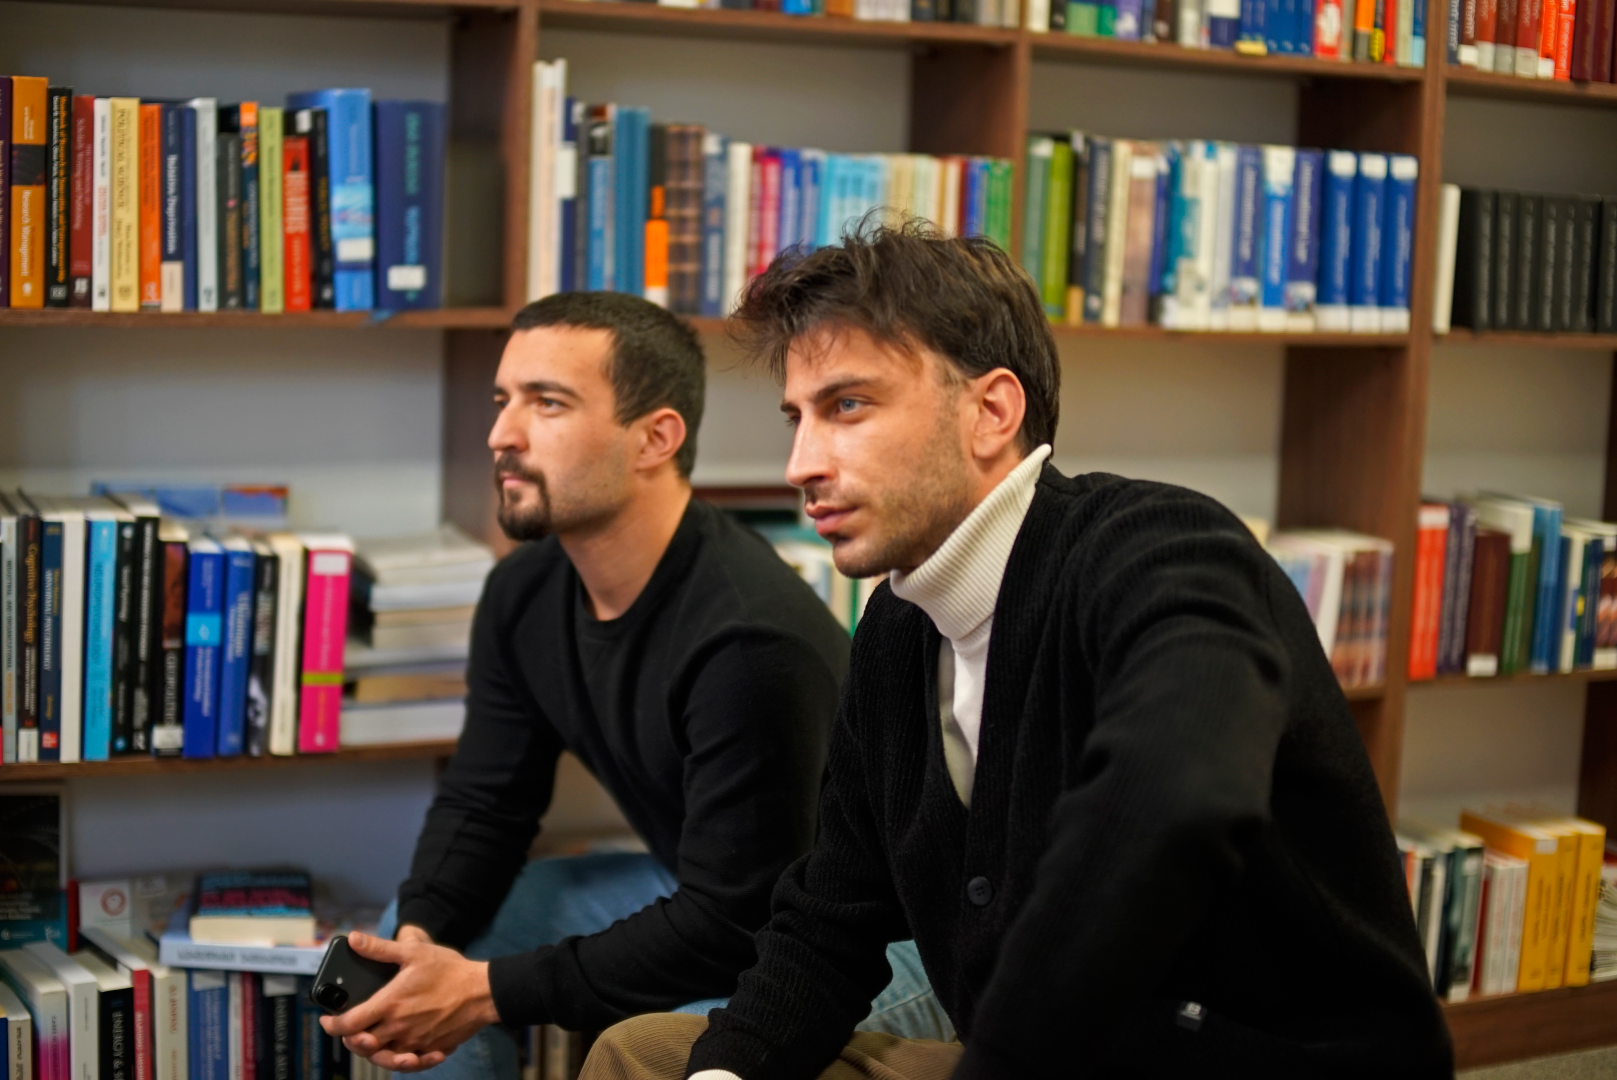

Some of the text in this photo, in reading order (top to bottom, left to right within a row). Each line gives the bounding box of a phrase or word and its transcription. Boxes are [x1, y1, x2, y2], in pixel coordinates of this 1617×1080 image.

[59, 138, 67, 168] Research
[75, 118, 86, 151] Scholarly
[116, 109, 127, 163] POLITICAL
[74, 151, 85, 178] Writing
[116, 166, 127, 209] SCIENCE
[18, 189, 32, 277] Research Management
[165, 195, 178, 255] Deprivation
[23, 543, 39, 645] Cognitive Psychology
[112, 1011, 125, 1058] ENERGY
[112, 1059, 124, 1070] &
